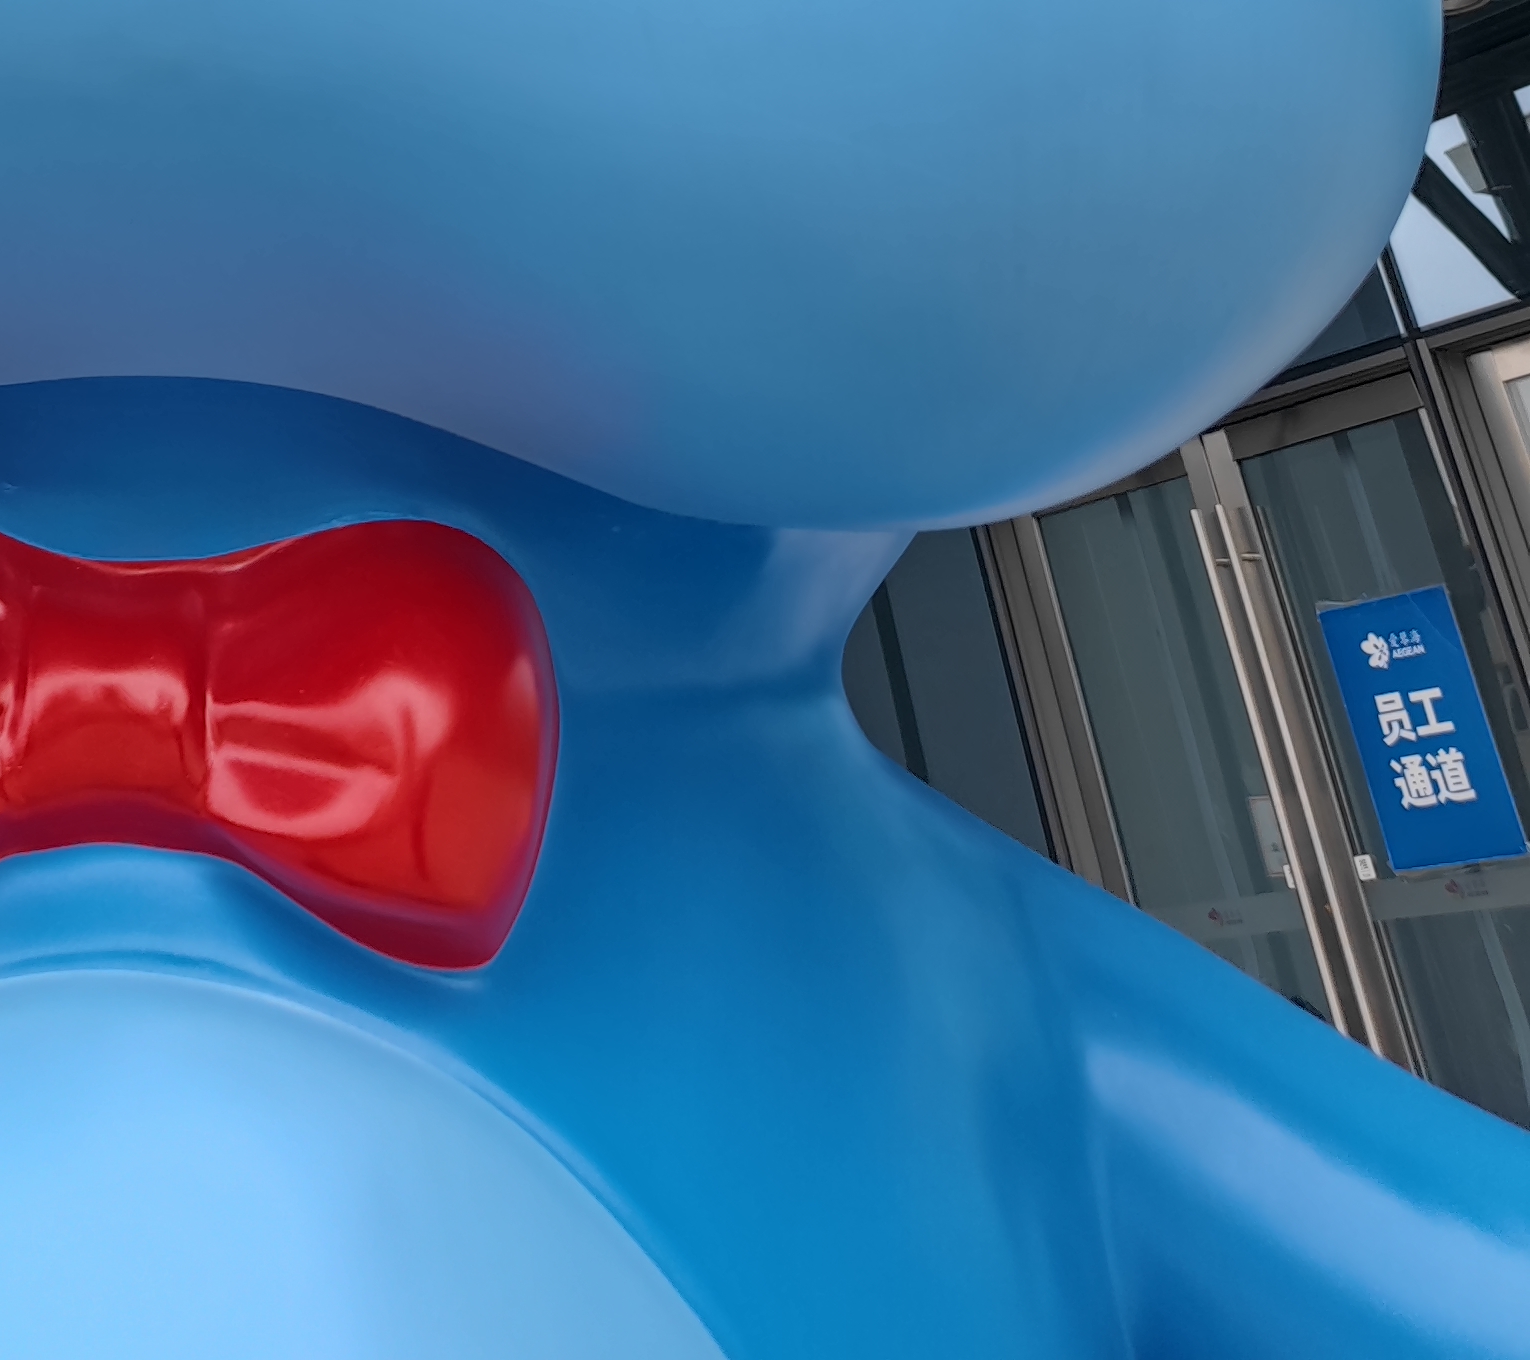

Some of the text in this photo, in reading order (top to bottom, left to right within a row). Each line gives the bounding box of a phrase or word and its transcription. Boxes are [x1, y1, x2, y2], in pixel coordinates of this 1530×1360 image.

[1392, 644, 1426, 659] AEGEAN
[1374, 686, 1455, 746] 员工
[1389, 747, 1477, 810] 通道
